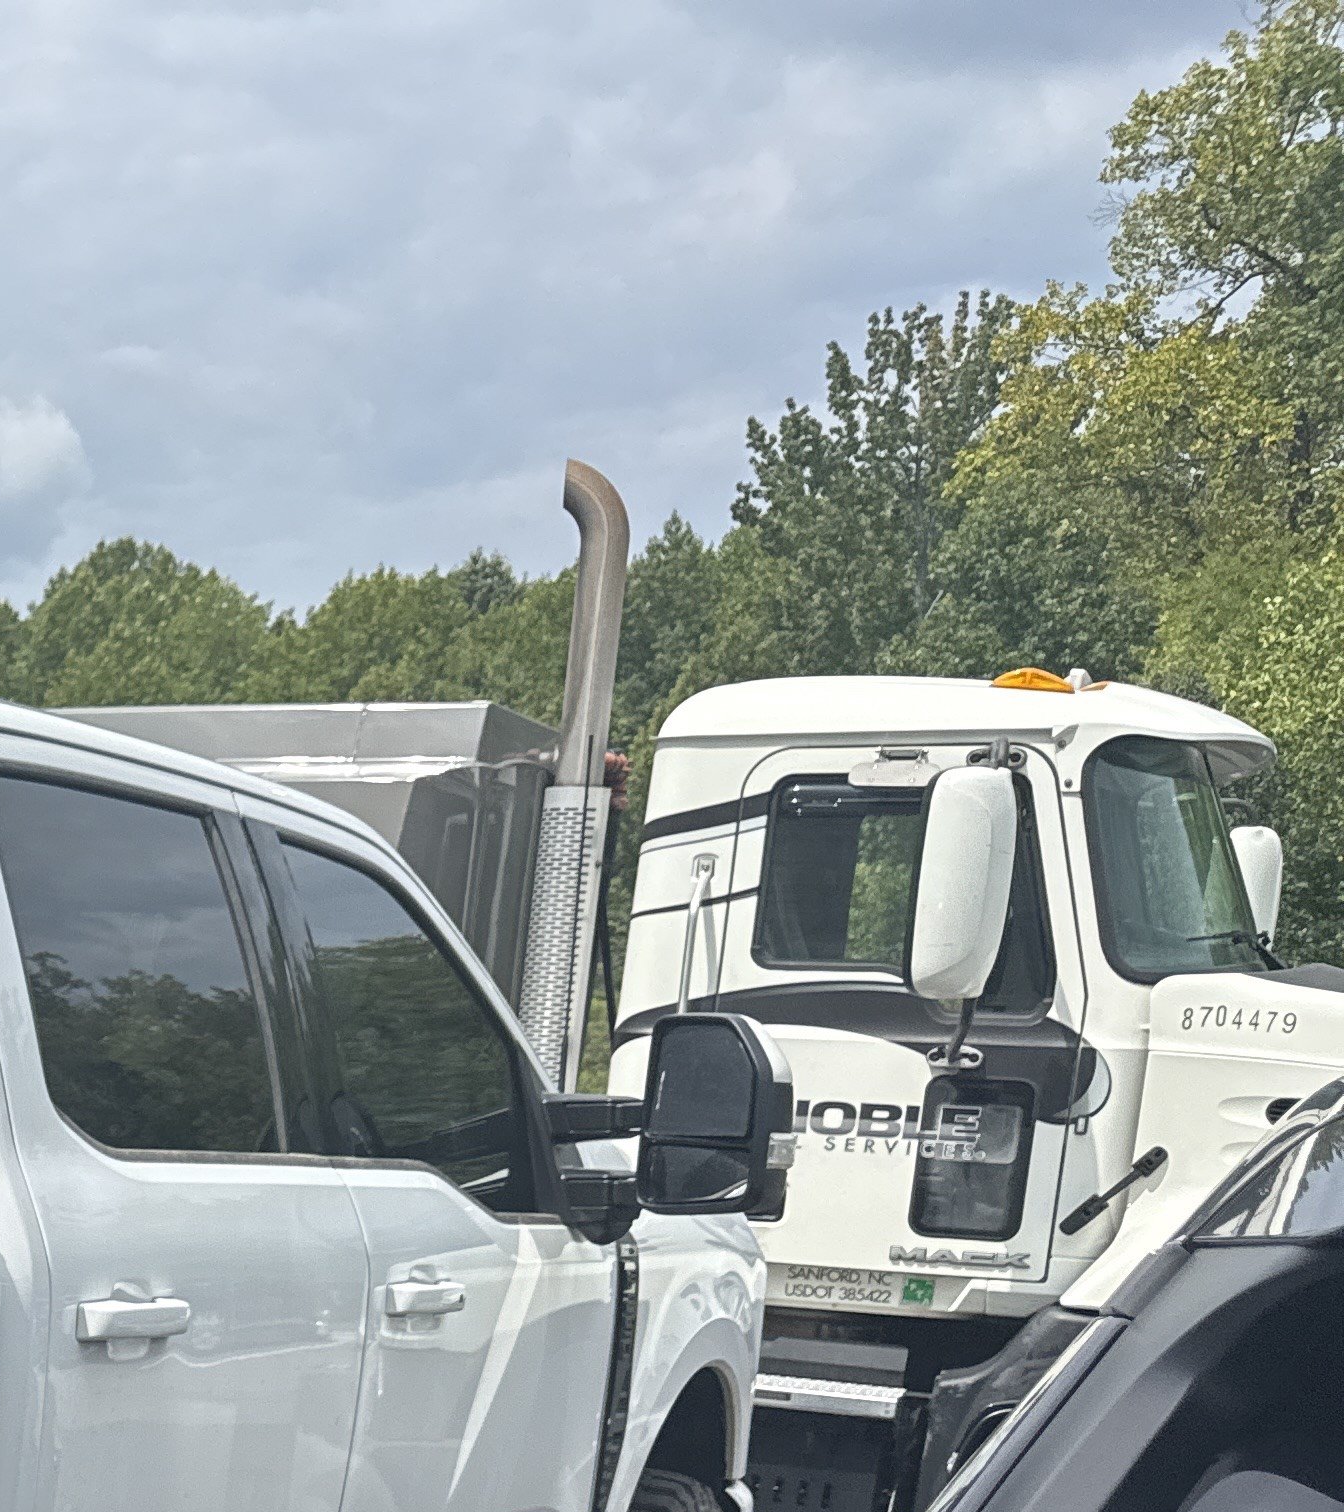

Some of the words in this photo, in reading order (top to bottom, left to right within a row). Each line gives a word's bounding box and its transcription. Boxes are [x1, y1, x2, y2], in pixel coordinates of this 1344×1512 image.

[1181, 1005, 1298, 1034] 8704479
[889, 1245, 1031, 1271] MACK
[787, 1265, 862, 1286] SANFORD,
[867, 1271, 892, 1287] NC
[785, 1284, 835, 1299] USDOT
